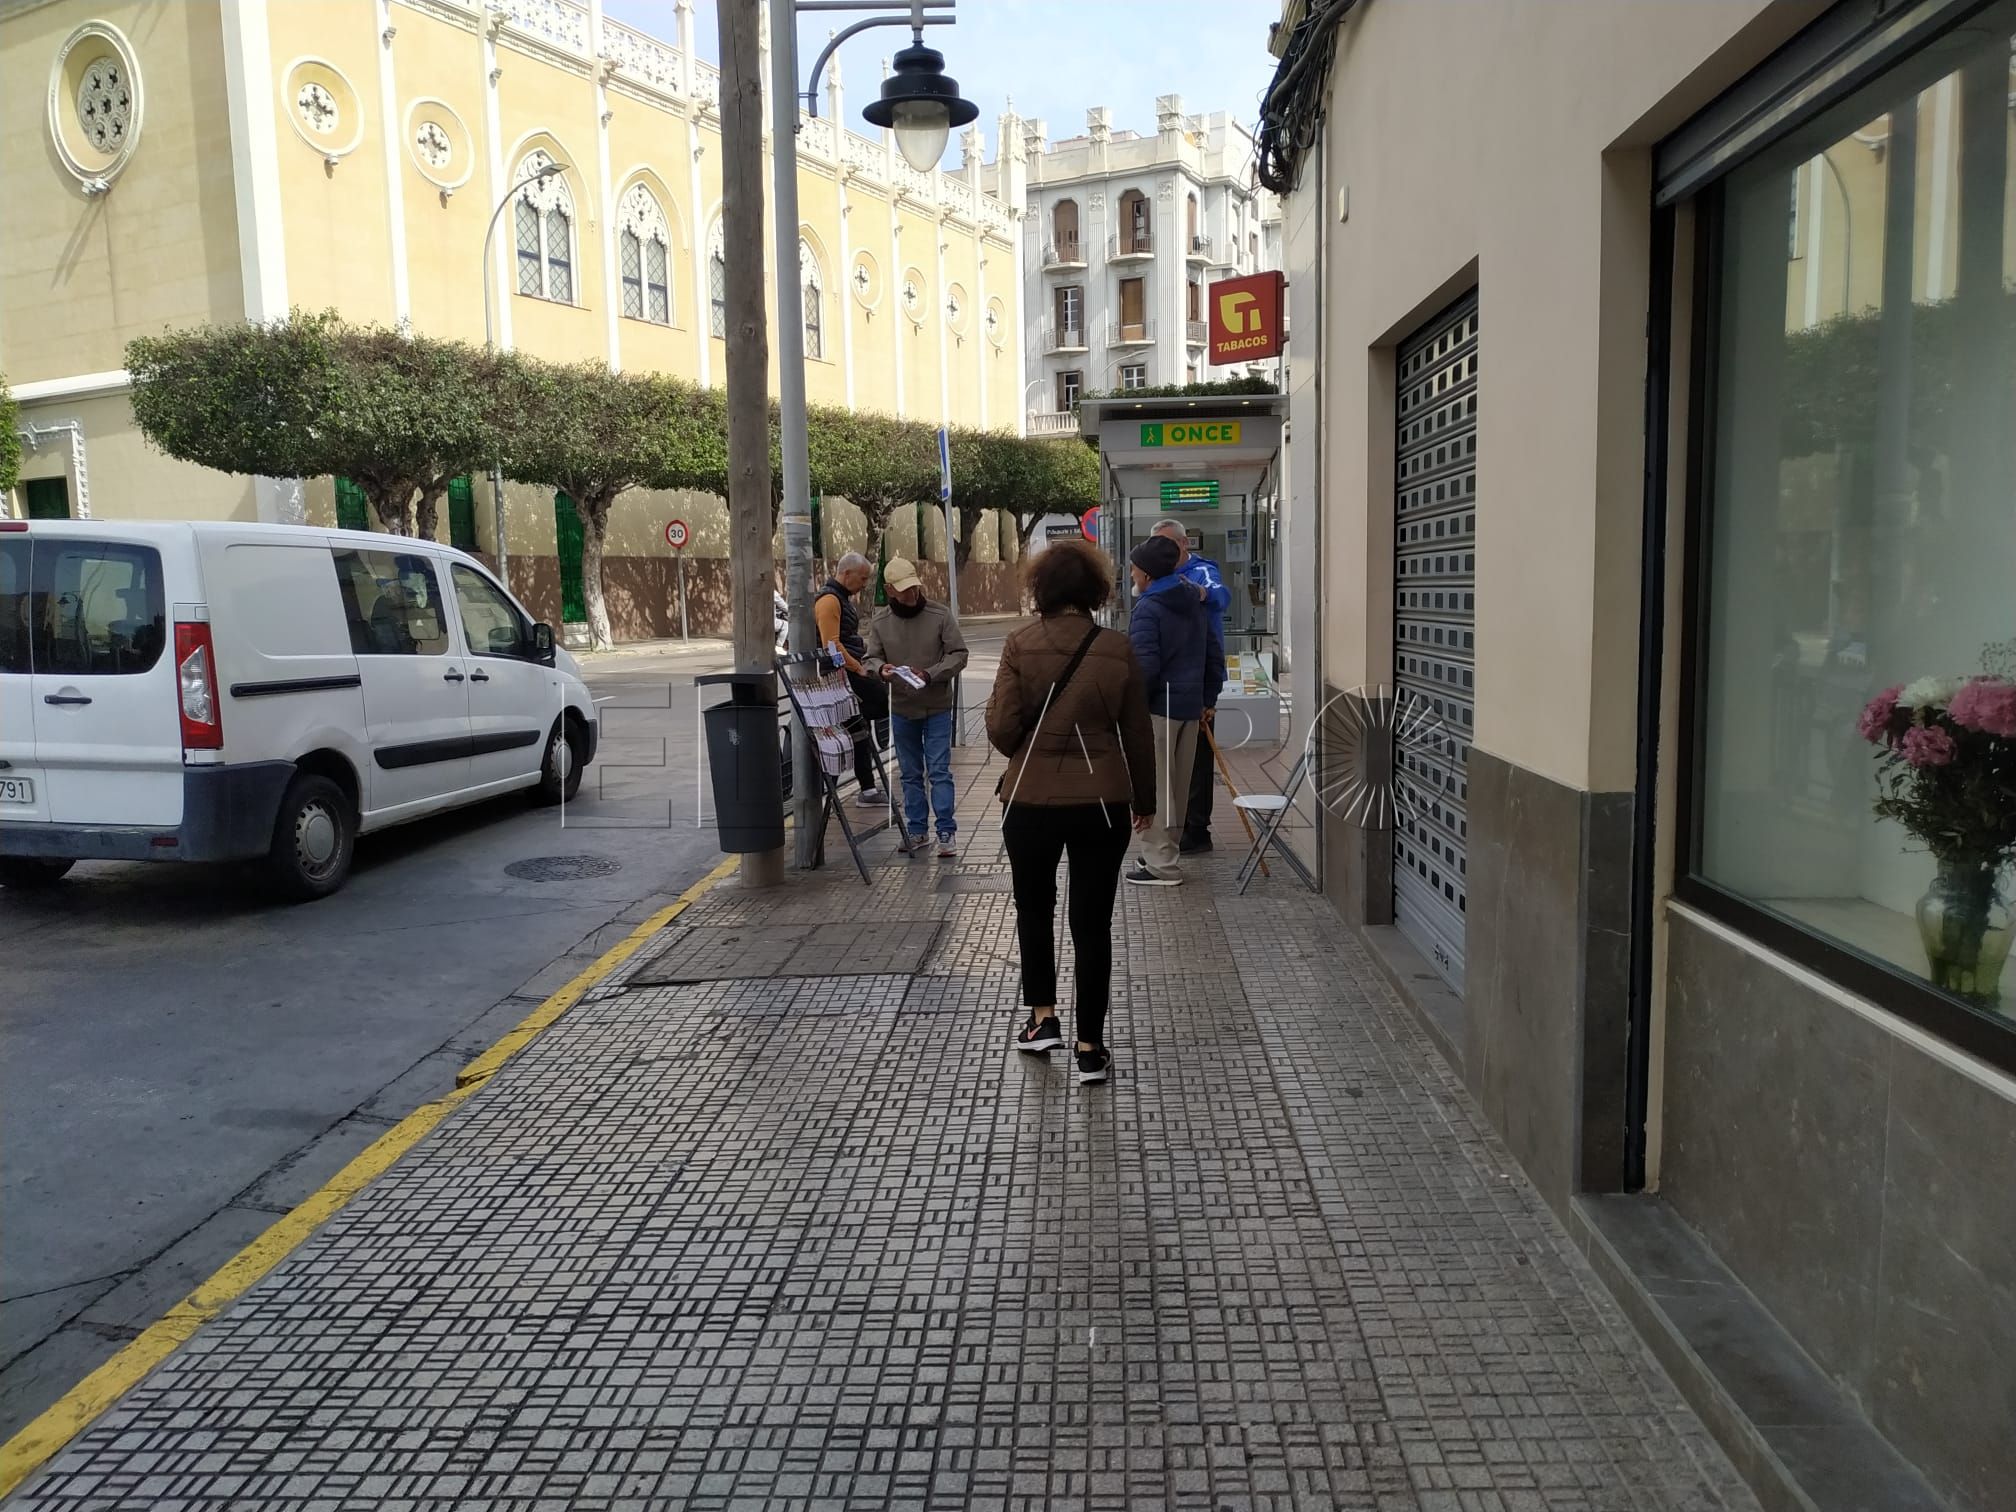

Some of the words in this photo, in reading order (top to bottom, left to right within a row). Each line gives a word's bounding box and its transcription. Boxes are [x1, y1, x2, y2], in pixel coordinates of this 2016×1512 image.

[1216, 335, 1268, 353] TABACOS
[1171, 424, 1233, 442] ONCE
[670, 529, 684, 539] 30
[0, 780, 25, 799] 791
